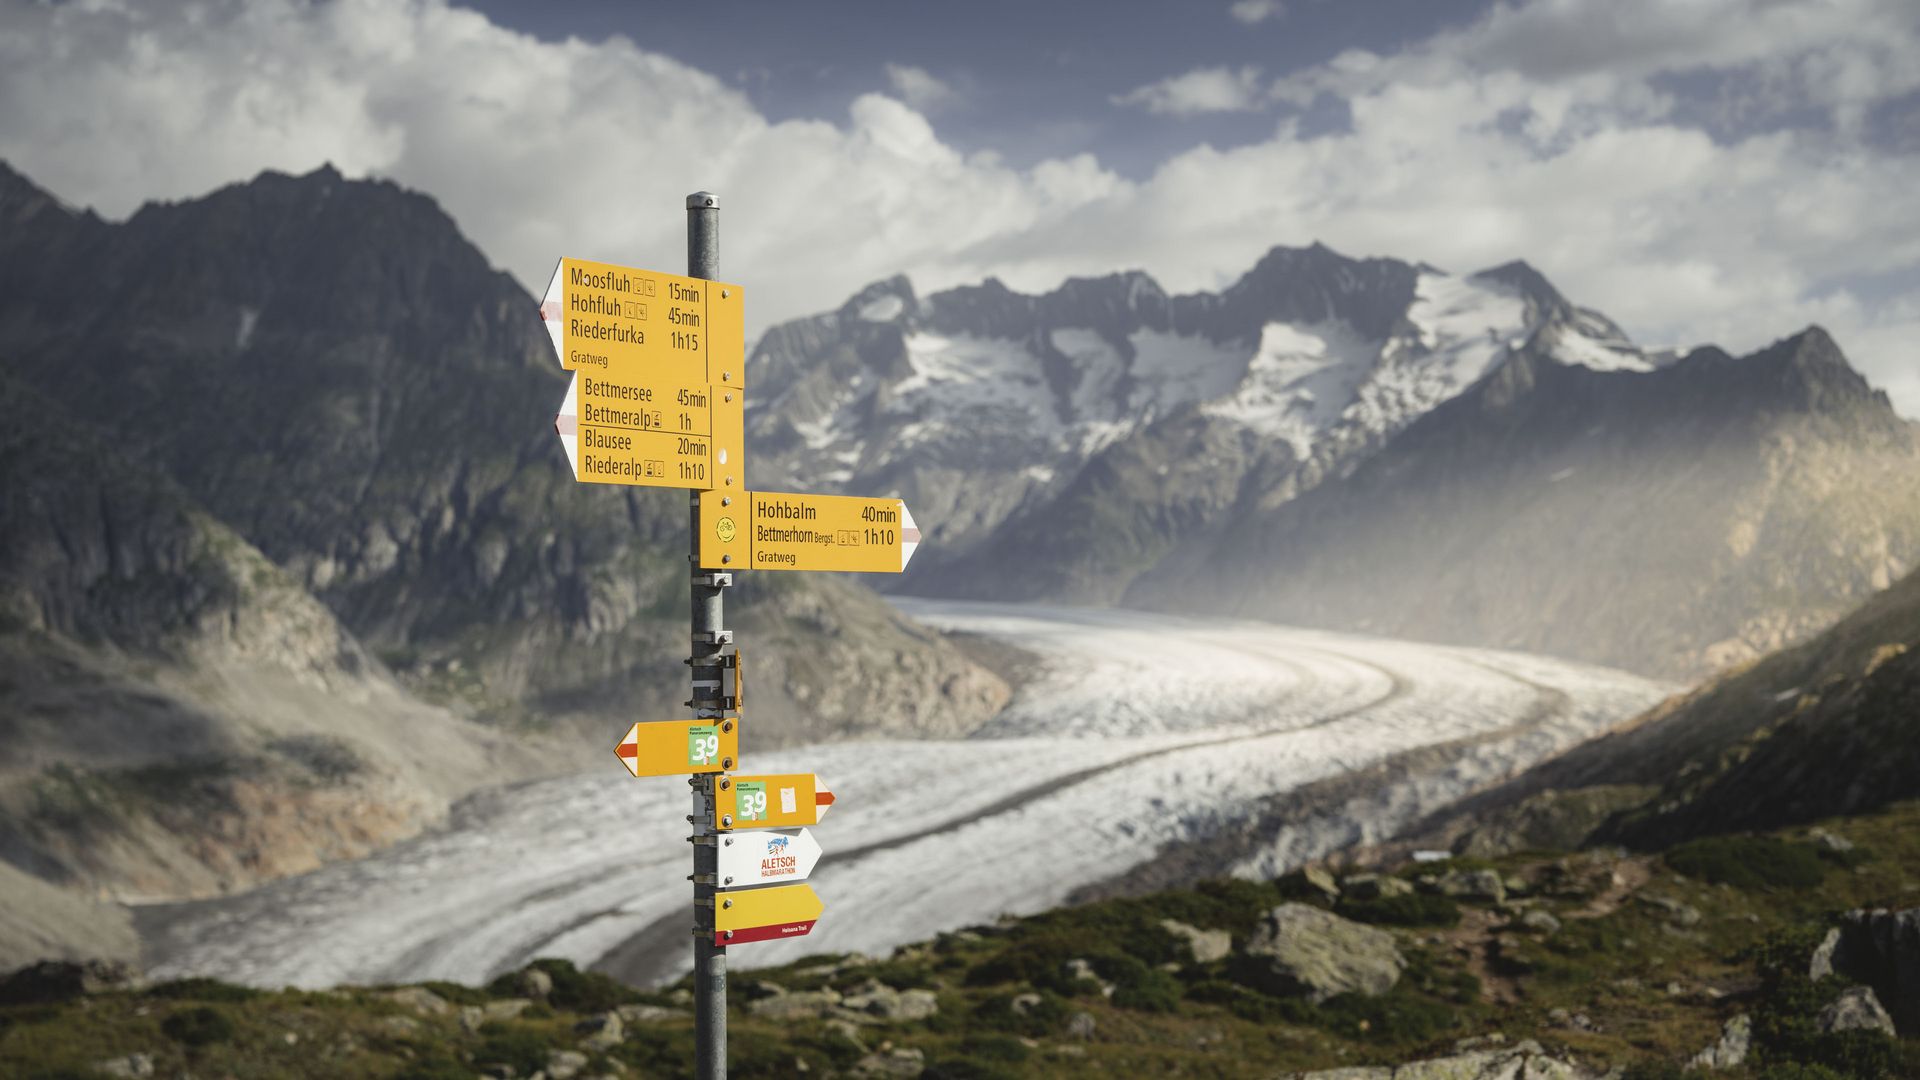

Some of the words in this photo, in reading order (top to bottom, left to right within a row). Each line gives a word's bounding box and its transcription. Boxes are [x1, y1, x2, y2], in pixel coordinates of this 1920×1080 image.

[571, 268, 630, 292] Moosfluh
[668, 282, 699, 303] 15min
[571, 294, 621, 316] Hohfluh
[668, 307, 700, 327] 45min
[571, 319, 644, 344] Riederfurka
[671, 332, 698, 351] 1h15
[571, 350, 608, 368] Gratweg
[585, 378, 652, 402] Bettmersee
[677, 389, 707, 408] 45min
[585, 404, 650, 430] Bettmeralp
[679, 413, 691, 431] 1h
[585, 429, 631, 450] Blausee
[678, 438, 707, 456] 20min
[585, 455, 641, 481] Riederalp
[679, 462, 704, 480] 1h10
[758, 501, 816, 520] Hohbalm
[862, 506, 896, 522] 40min
[757, 525, 813, 543] Bettmerhorn
[815, 531, 835, 546] Bergst.
[864, 529, 894, 545] 1h10
[757, 551, 796, 565] Gratweg
[692, 735, 719, 761] 39
[740, 791, 767, 816] 39
[761, 856, 796, 869] ALETSCH
